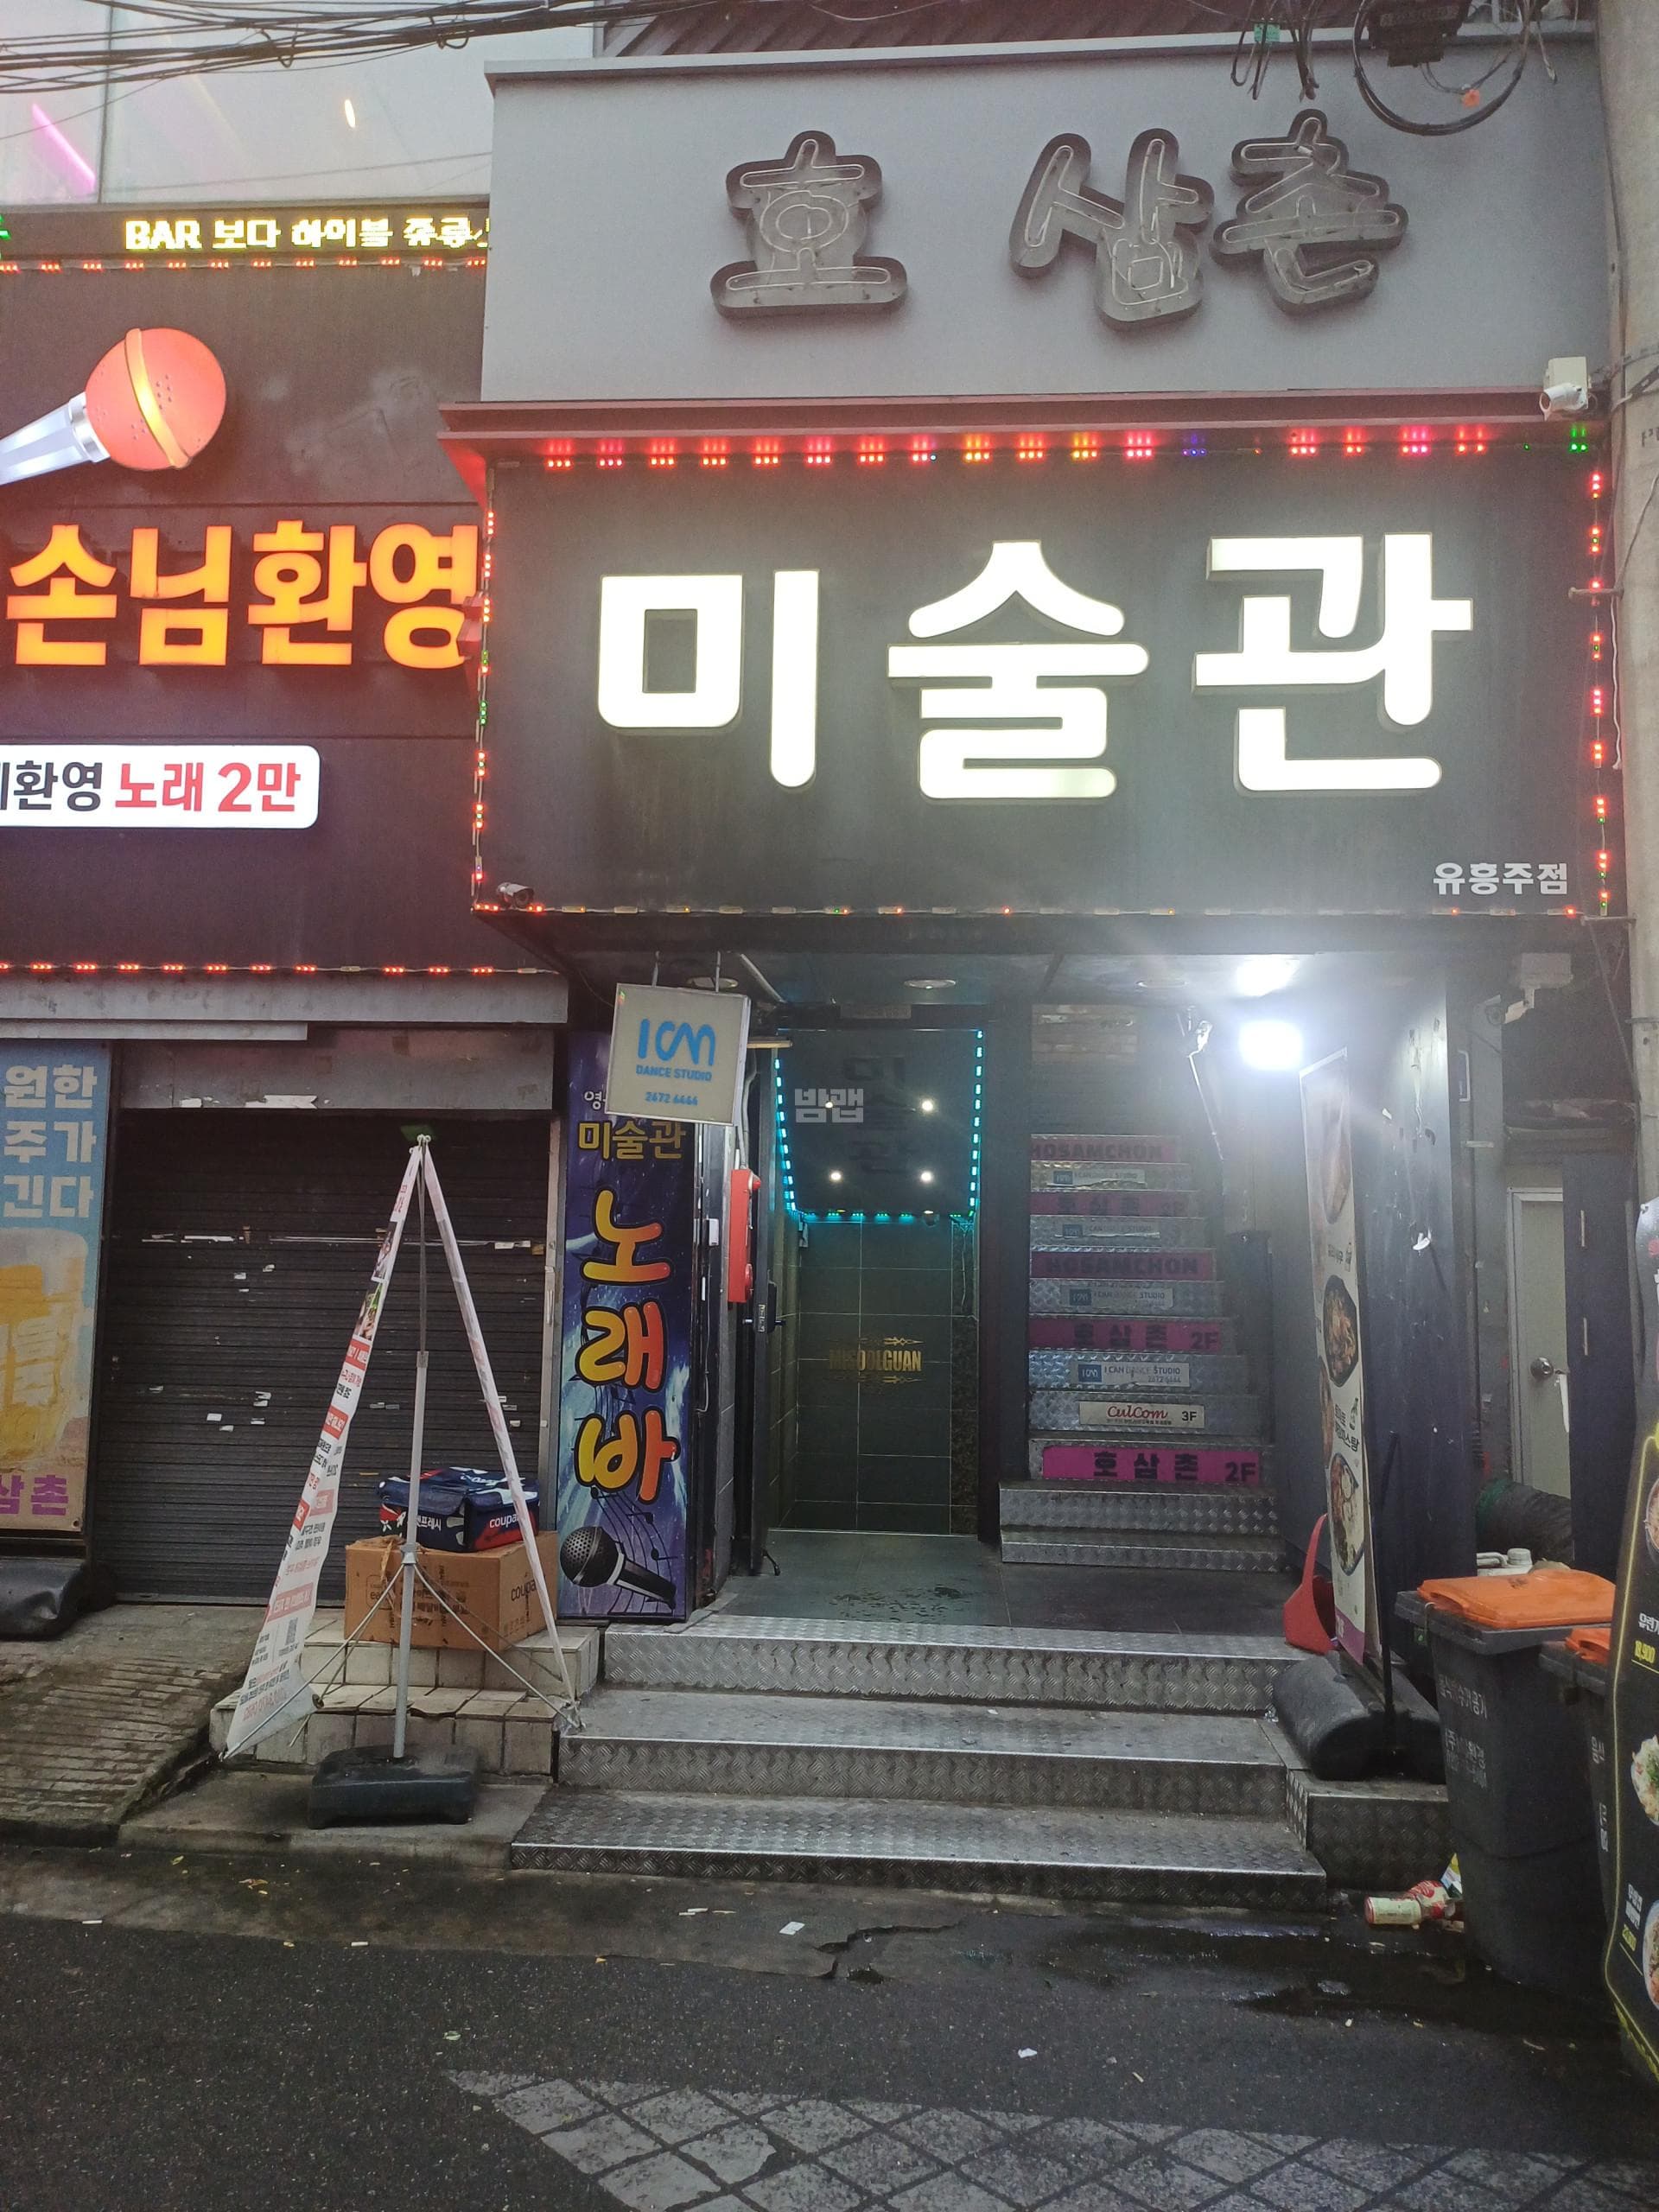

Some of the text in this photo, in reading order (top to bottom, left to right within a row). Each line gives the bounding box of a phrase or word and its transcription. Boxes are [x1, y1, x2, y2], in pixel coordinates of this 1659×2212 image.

[125, 219, 202, 250] BAR
[213, 219, 282, 250] 보다
[710, 130, 907, 319] 호
[597, 533, 1473, 804] 미술관
[115, 761, 204, 812] 노래
[217, 761, 301, 813] 2만
[1433, 862, 1567, 895] 유흥주점
[3, 1064, 98, 1109] 원한
[636, 1064, 713, 1082] DANCE STUDIO
[3, 1120, 97, 1164] 주가
[578, 1121, 687, 1160] 미술관
[3, 1174, 94, 1218] 긴다
[1154, 1365, 1181, 1375] STUDIO
[1106, 1404, 1168, 1420] CulCom
[1181, 1410, 1198, 1422] 3F
[1093, 1451, 1256, 1482] 호삼촌 2F
[489, 1513, 519, 1529] coupa
[511, 1579, 537, 1602] coupa
